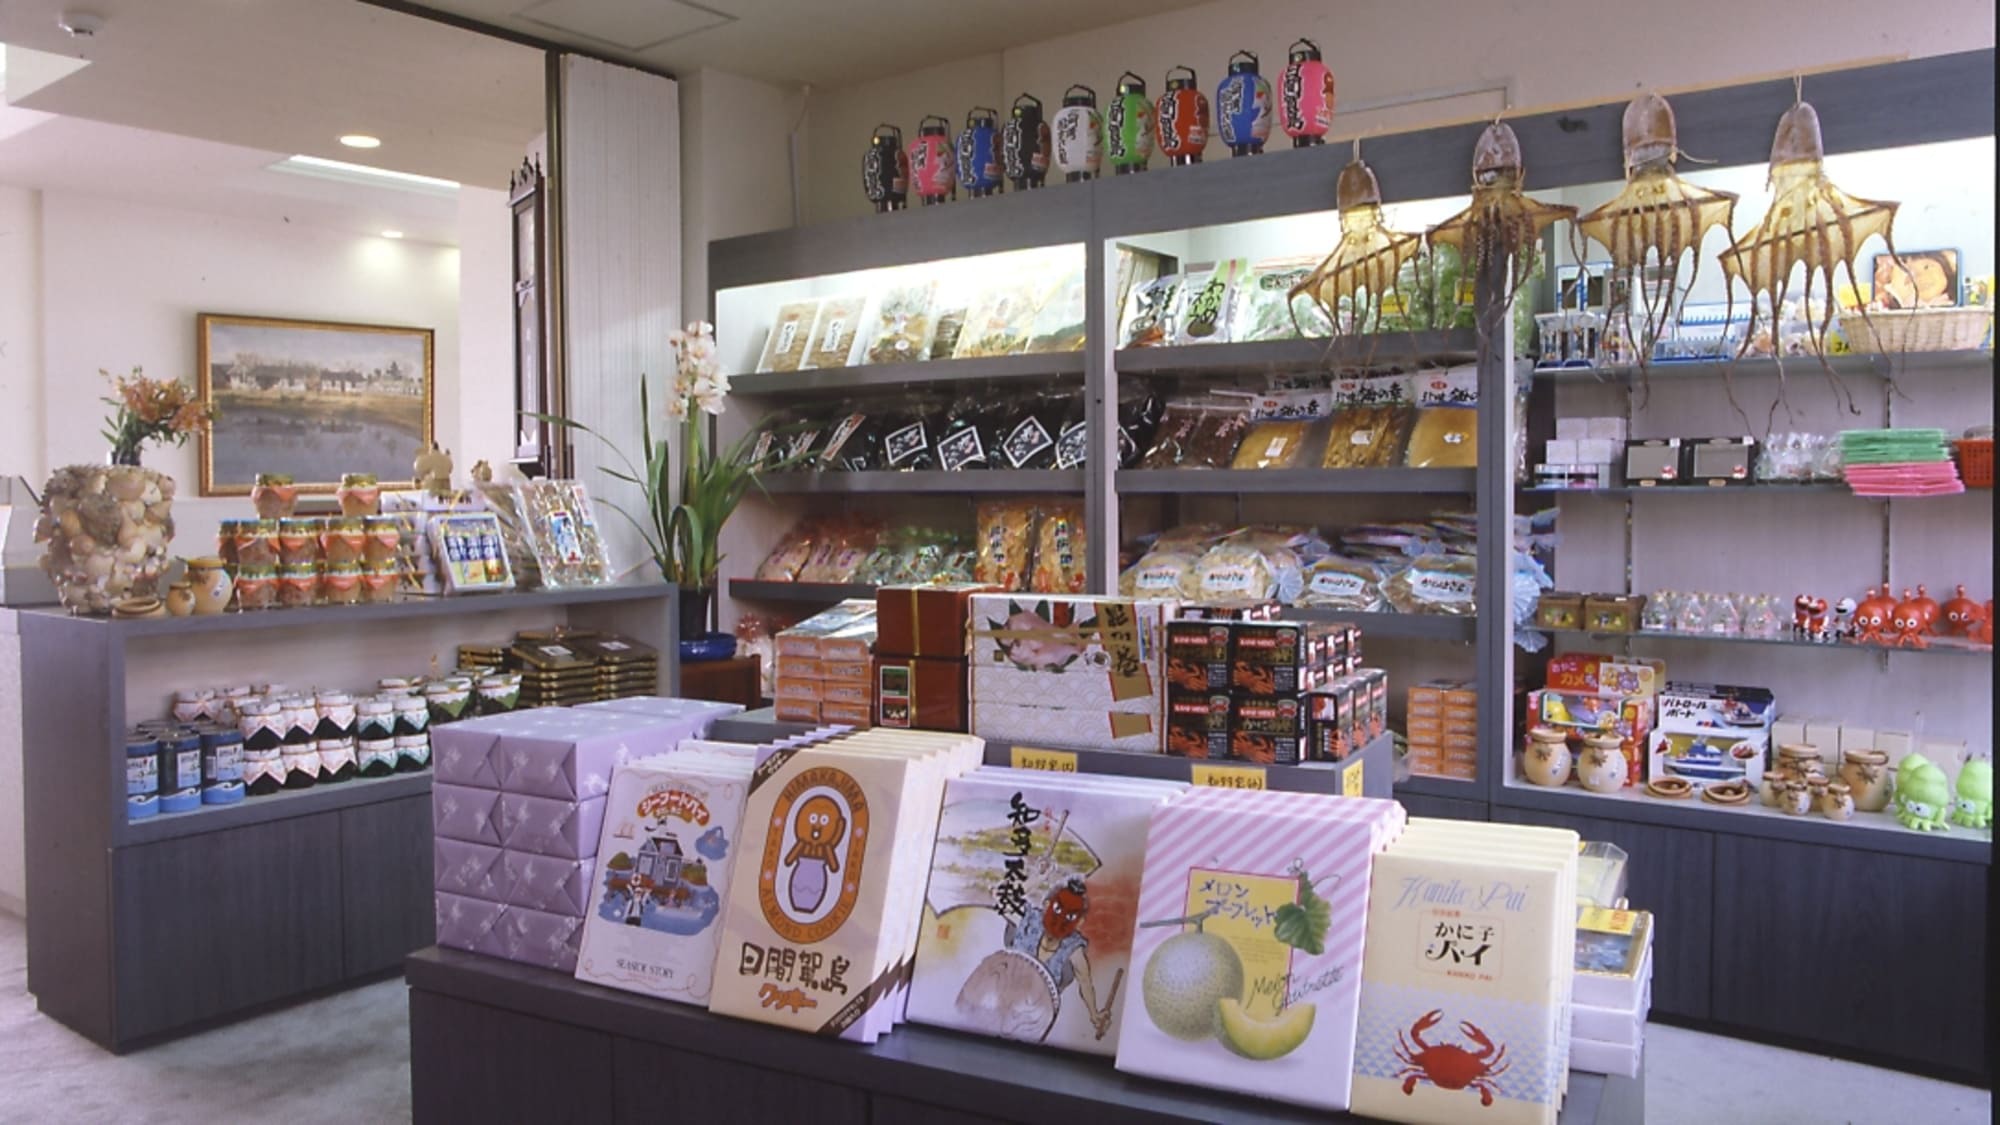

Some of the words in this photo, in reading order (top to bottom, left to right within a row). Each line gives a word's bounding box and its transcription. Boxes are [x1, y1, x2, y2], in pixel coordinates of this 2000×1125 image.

[1664, 698, 1707, 710] パトロール
[1665, 708, 1696, 718] ボート
[1199, 879, 1249, 898] メロン
[1435, 921, 1495, 942] かに子
[1425, 939, 1492, 966] パイ
[740, 942, 850, 996] 日間賀島
